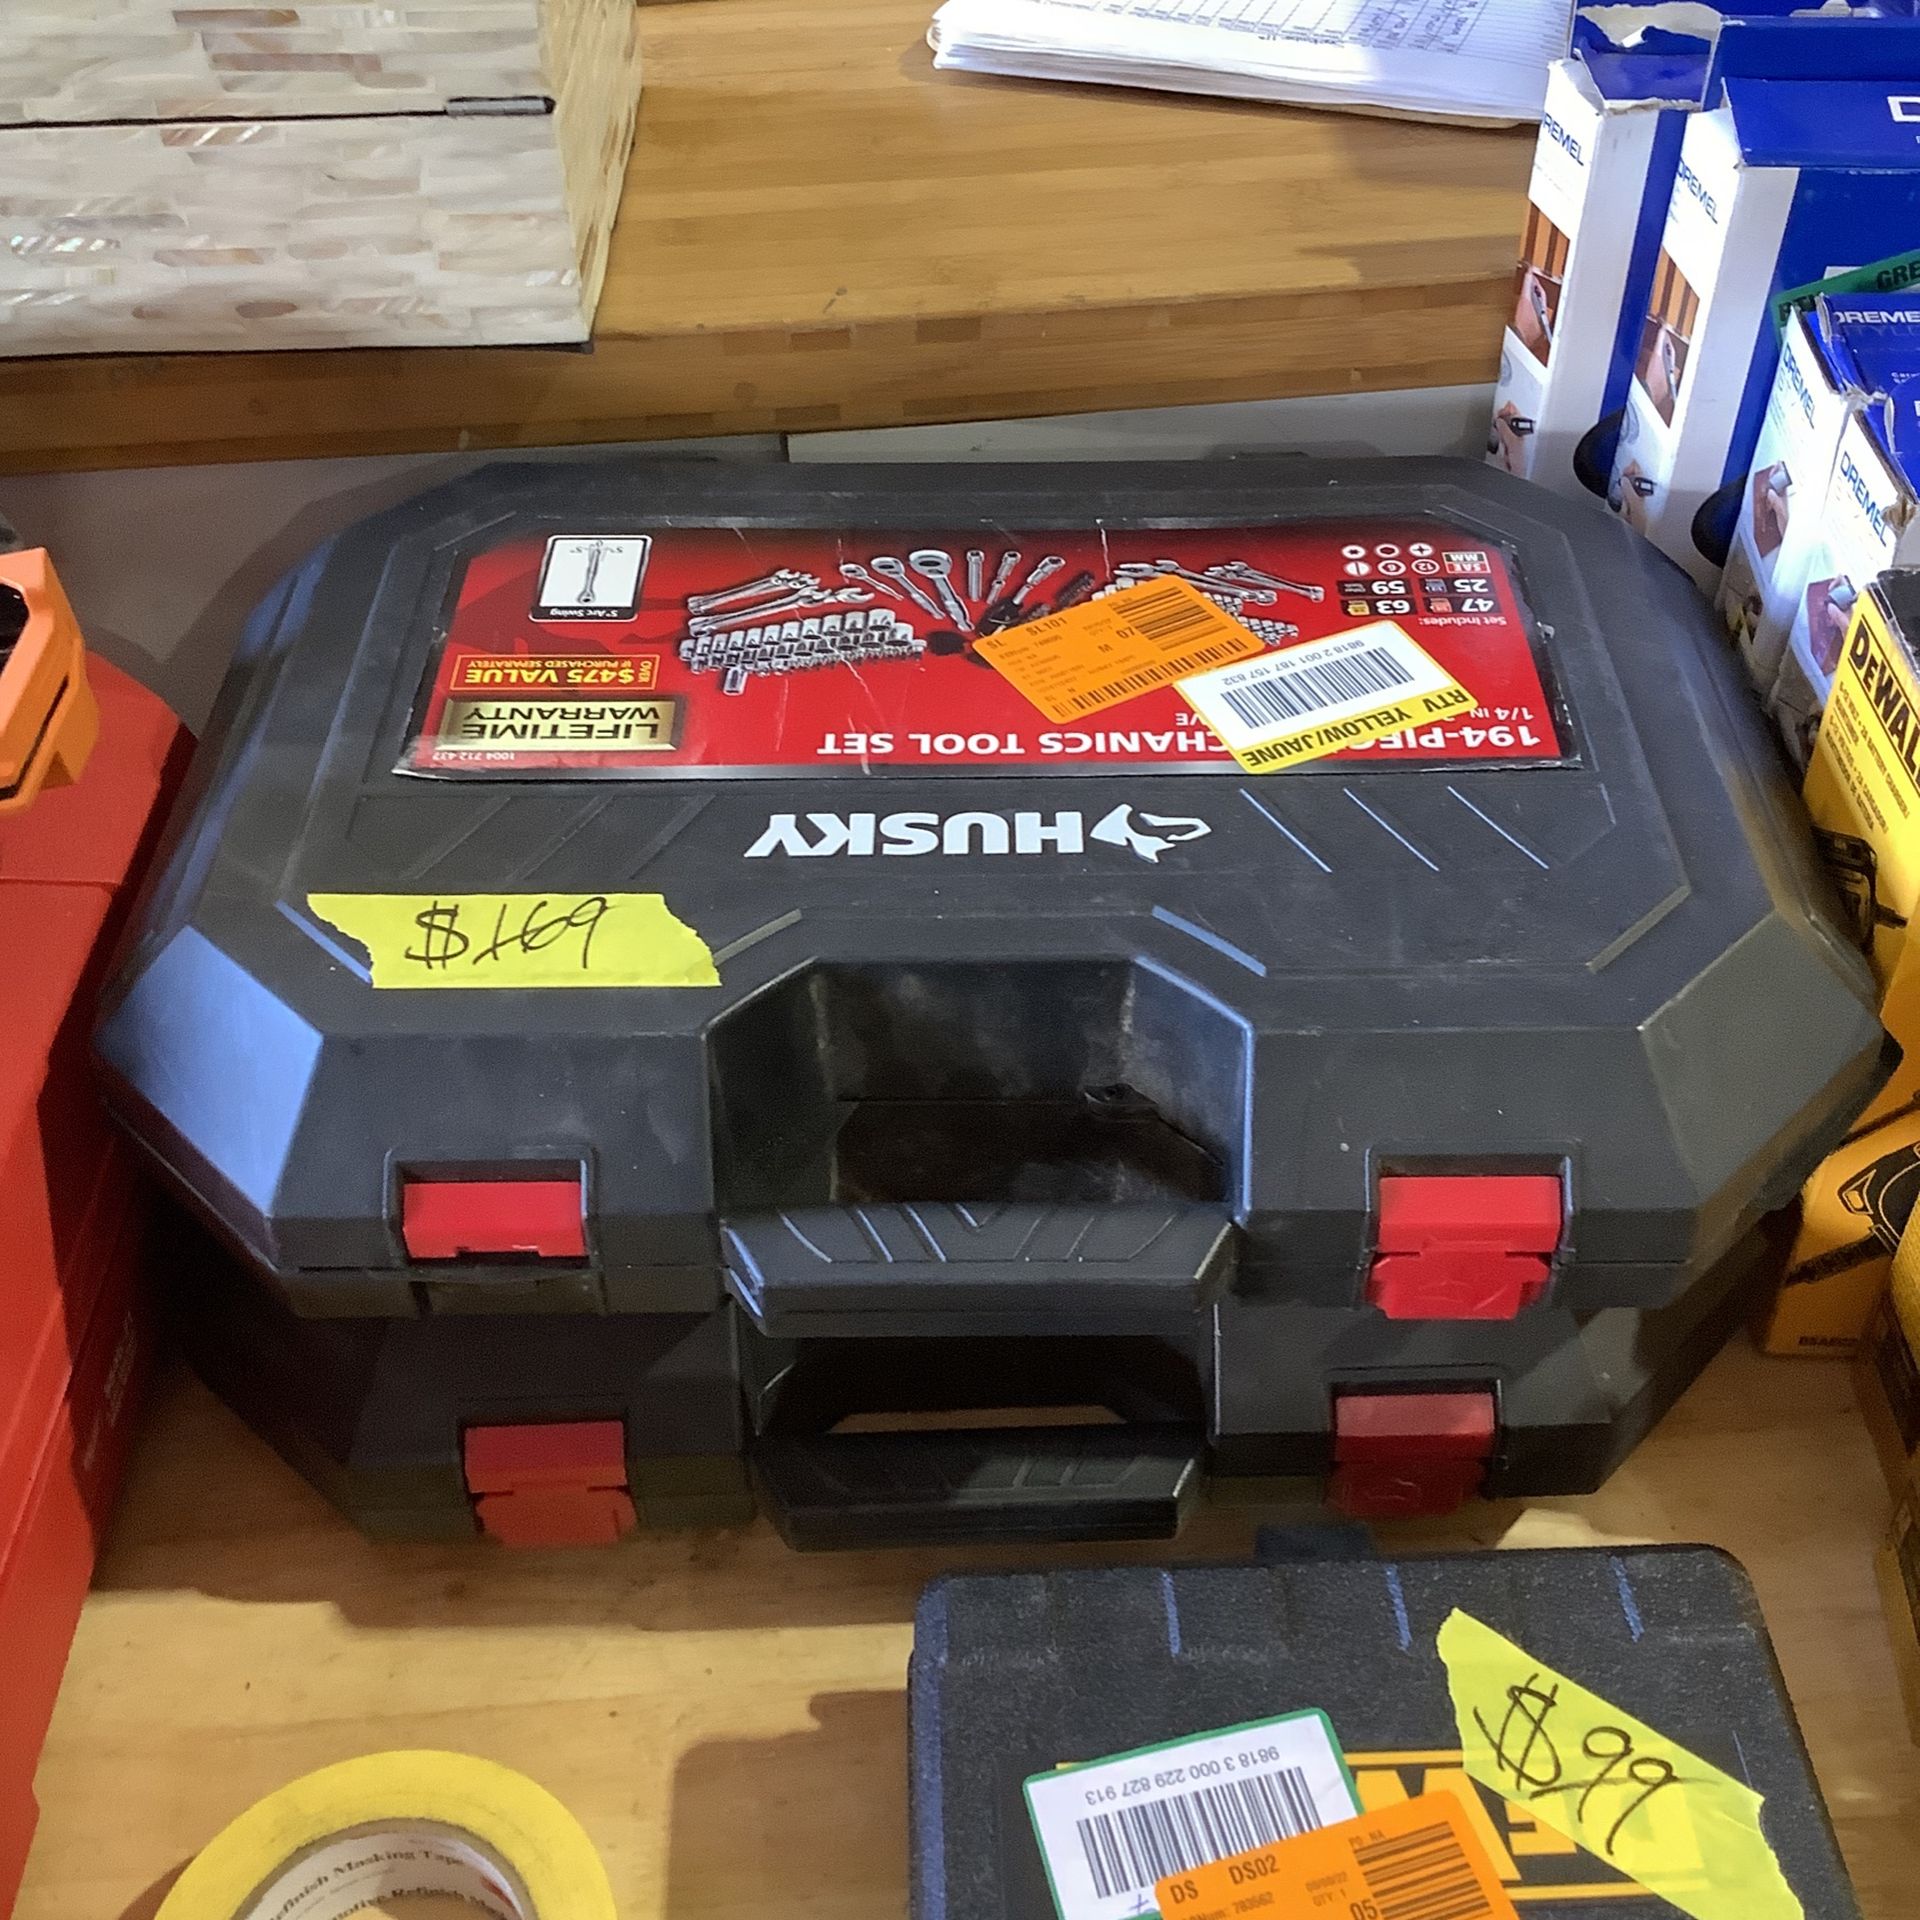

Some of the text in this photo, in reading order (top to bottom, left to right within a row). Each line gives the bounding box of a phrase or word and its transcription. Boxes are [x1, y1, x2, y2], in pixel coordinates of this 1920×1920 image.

[1542, 113, 1585, 166] REMEL
[1876, 260, 1920, 292] GRE
[1833, 311, 1920, 324] REME
[1840, 451, 1887, 548] DREMEL
[1371, 580, 1406, 594] 59
[1454, 579, 1489, 593] 25
[1376, 600, 1410, 614] 63
[1462, 599, 1494, 613] 47
[1419, 617, 1507, 627] Set Includes:
[1299, 652, 1323, 665] 001
[1324, 648, 1333, 657] 2
[467, 660, 543, 668] SEPARATELY
[545, 660, 619, 668] PURCHASED
[464, 668, 636, 685] $475 VALUE
[463, 707, 661, 720] WARRANTY
[1495, 707, 1534, 721] 1/4
[462, 723, 660, 740] LIFETIME
[1241, 688, 1470, 768] RTV YELLOW/JAUNE
[816, 725, 1541, 755] 194-PIE CHANICS TOOL SET
[743, 811, 1084, 857] HUSKY
[404, 896, 608, 970] $169
[1473, 1673, 1680, 1857] $99
[1085, 1746, 1281, 1806] 9818 3 000 229 827 913
[270, 1874, 329, 1920] efinish
[332, 1850, 416, 1876] Masking
[1169, 1879, 1200, 1905] DS
[1228, 1853, 1281, 1886] DS02
[1350, 1899, 1379, 1920] 05
